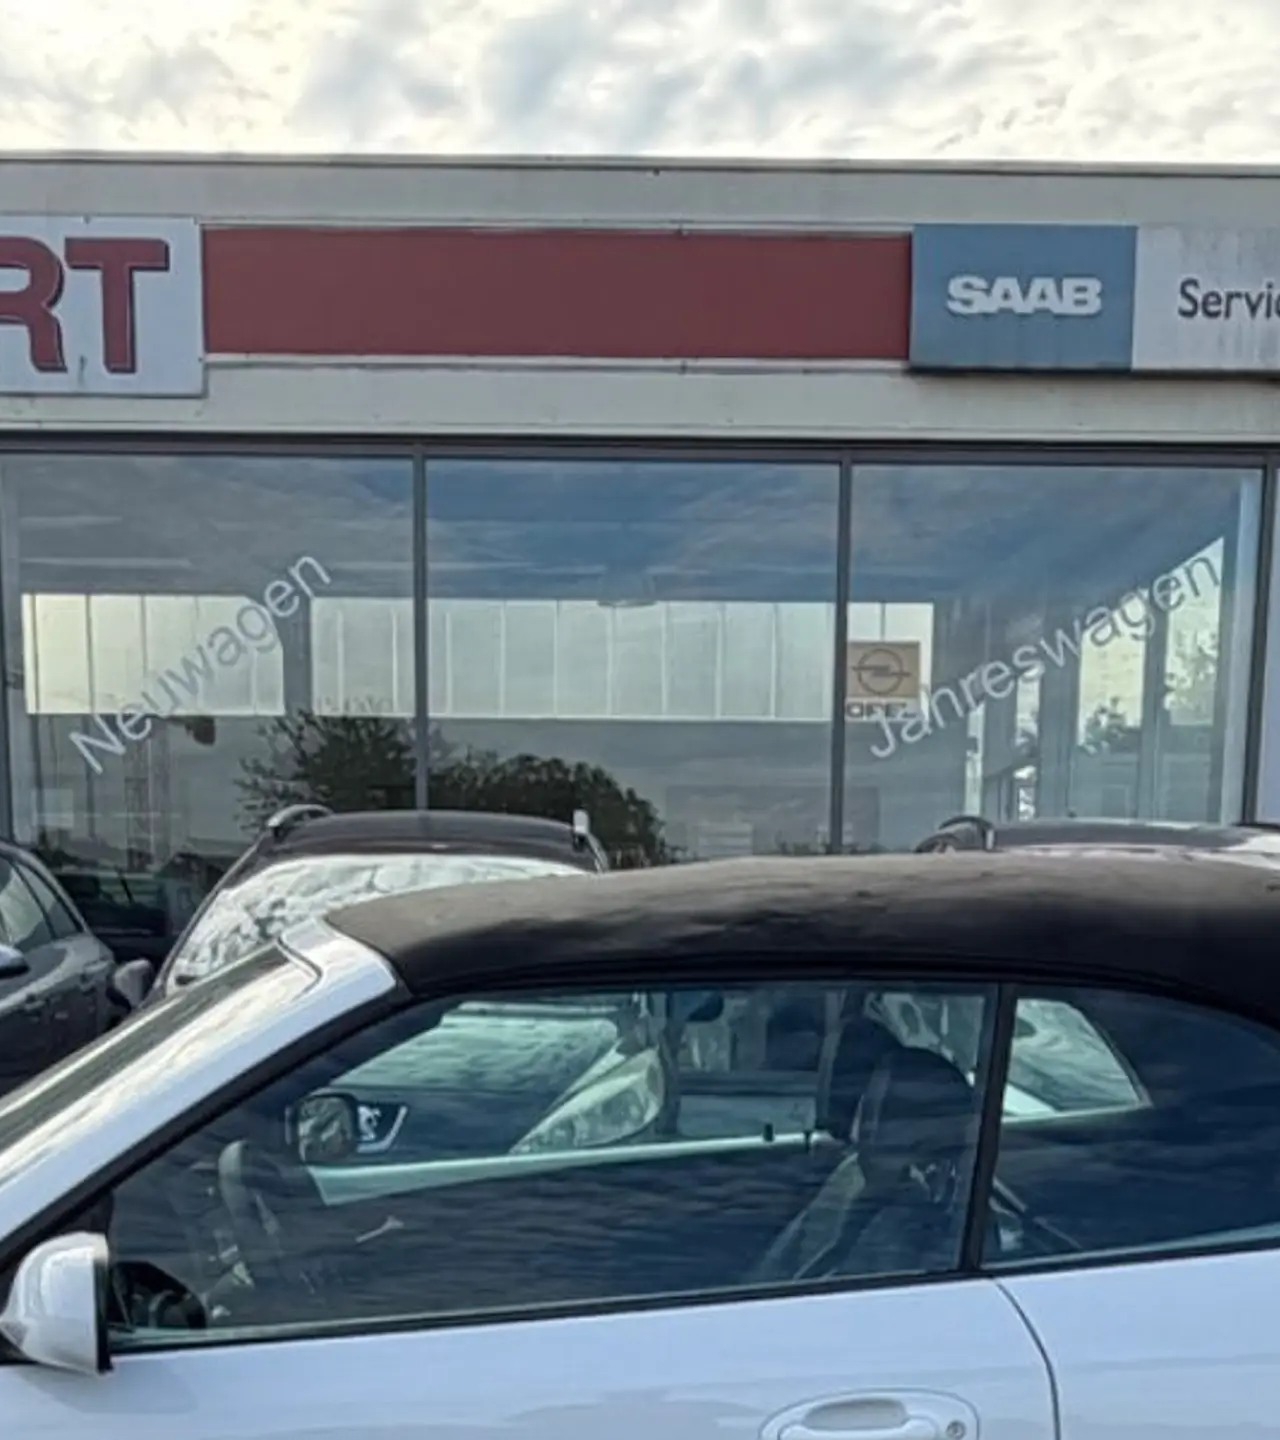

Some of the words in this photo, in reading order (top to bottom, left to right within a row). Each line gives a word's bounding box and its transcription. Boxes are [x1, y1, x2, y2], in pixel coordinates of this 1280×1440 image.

[947, 275, 1103, 317] SAAB
[69, 555, 332, 774] Neuwagen
[869, 556, 1221, 759] Jahreswagen
